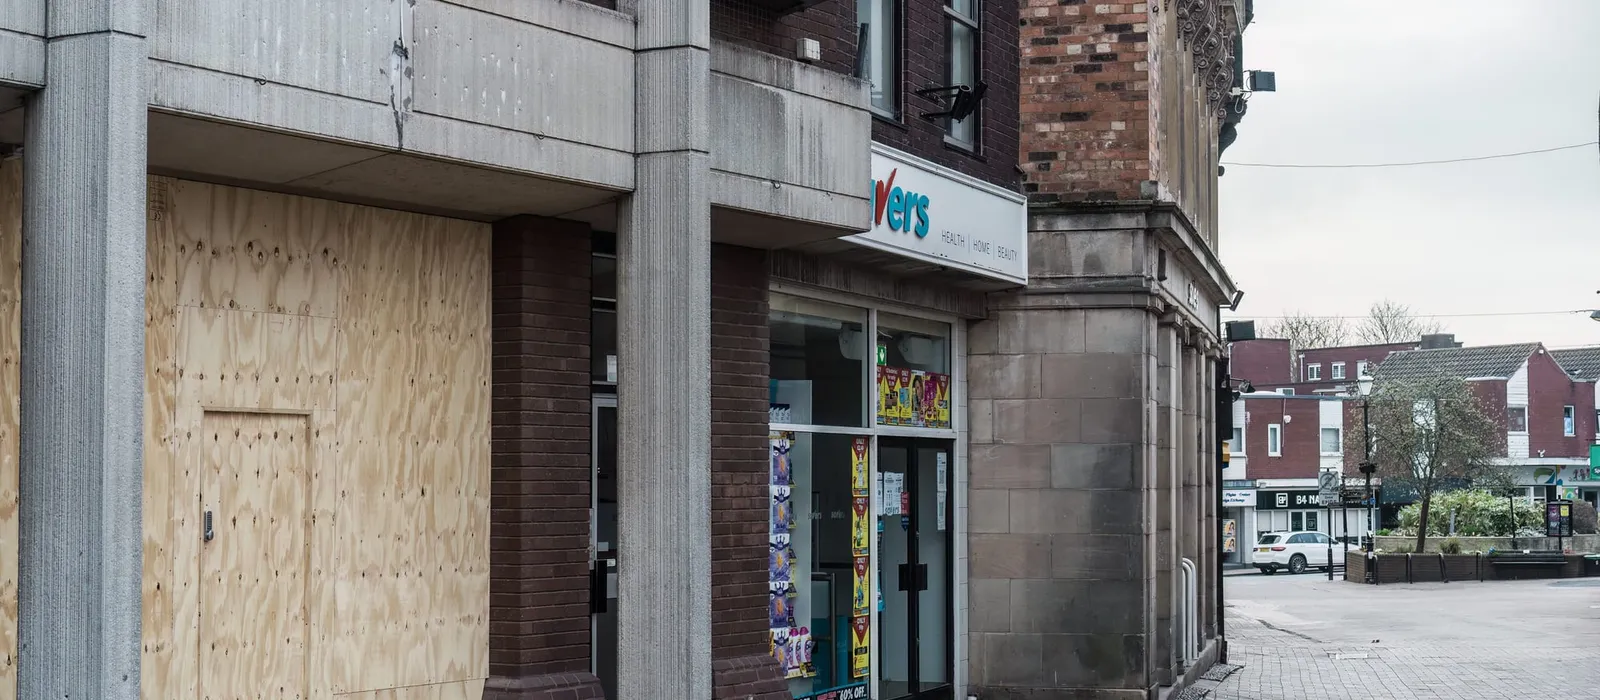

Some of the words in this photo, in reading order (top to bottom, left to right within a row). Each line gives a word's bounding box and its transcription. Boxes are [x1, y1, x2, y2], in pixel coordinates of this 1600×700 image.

[870, 168, 930, 239] vers
[941, 230, 965, 248] HEALTH
[973, 239, 990, 255] HOME
[997, 246, 1018, 262] BEAUTY
[840, 687, 854, 700] 60%
